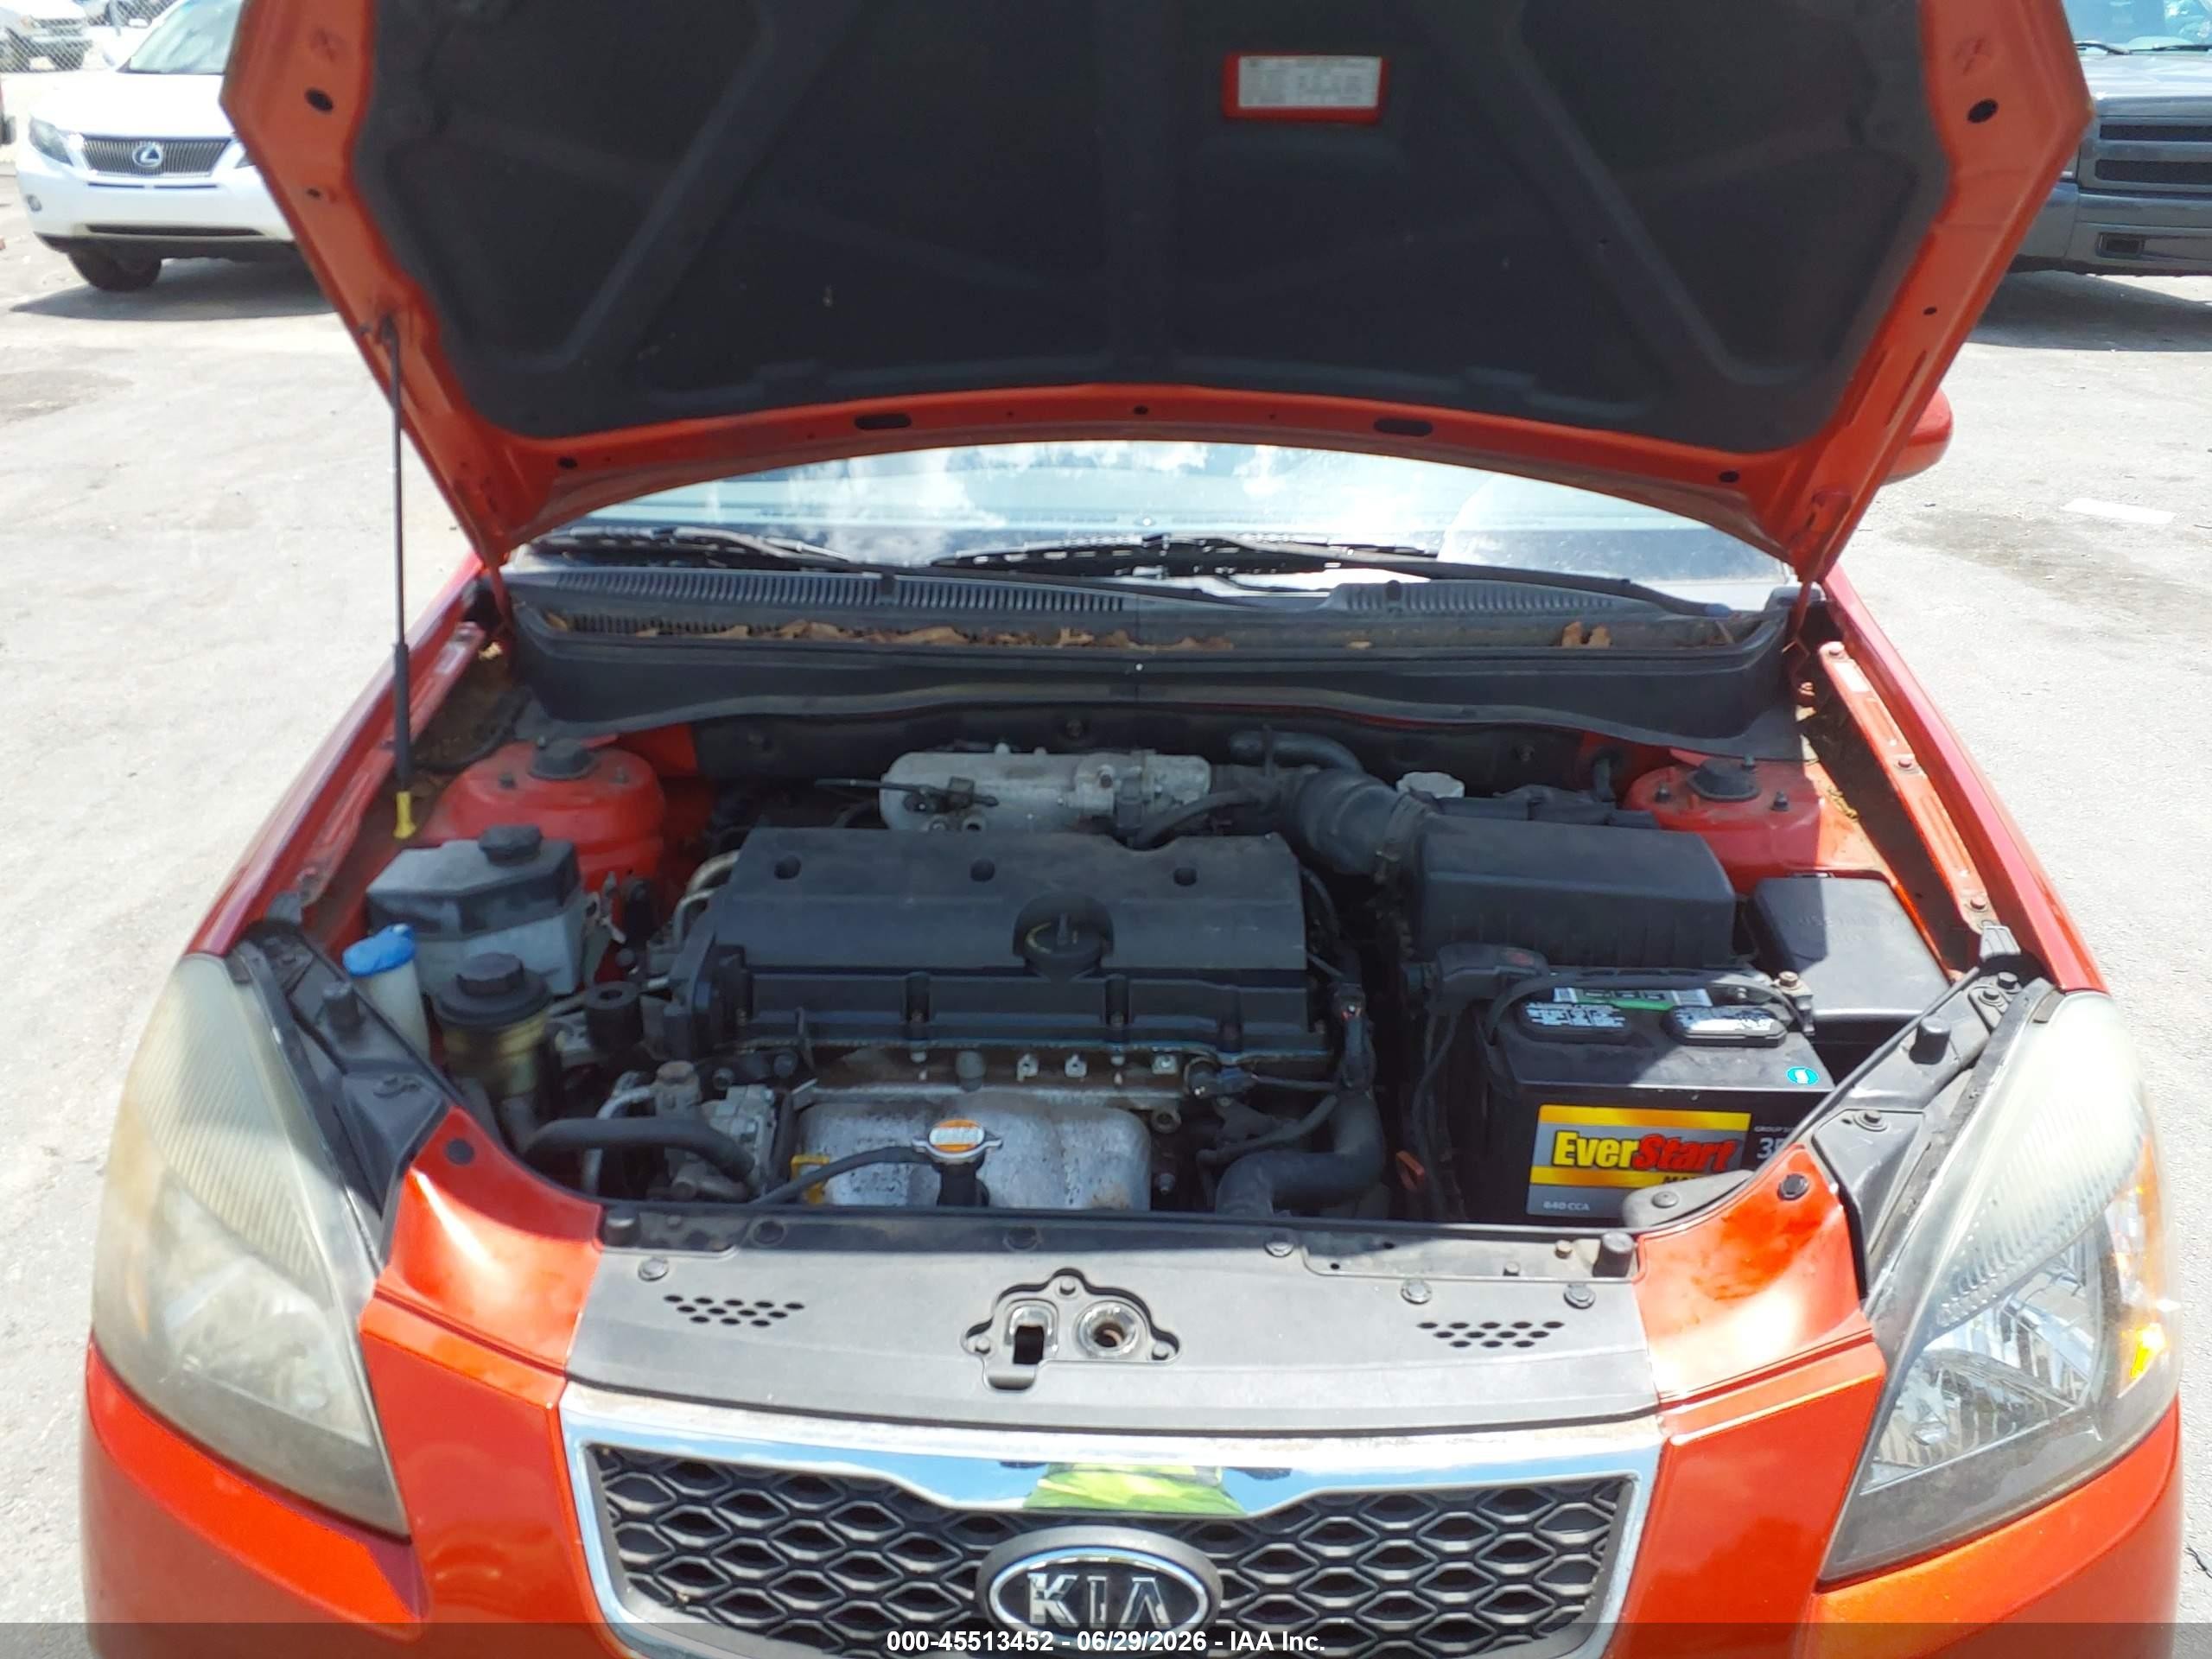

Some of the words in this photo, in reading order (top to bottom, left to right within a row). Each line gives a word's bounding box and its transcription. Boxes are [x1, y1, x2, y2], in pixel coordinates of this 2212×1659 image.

[1553, 1130, 1738, 1173] EverStart
[1567, 1202, 1591, 1211] CCA
[1027, 1573, 1172, 1630] KIA
